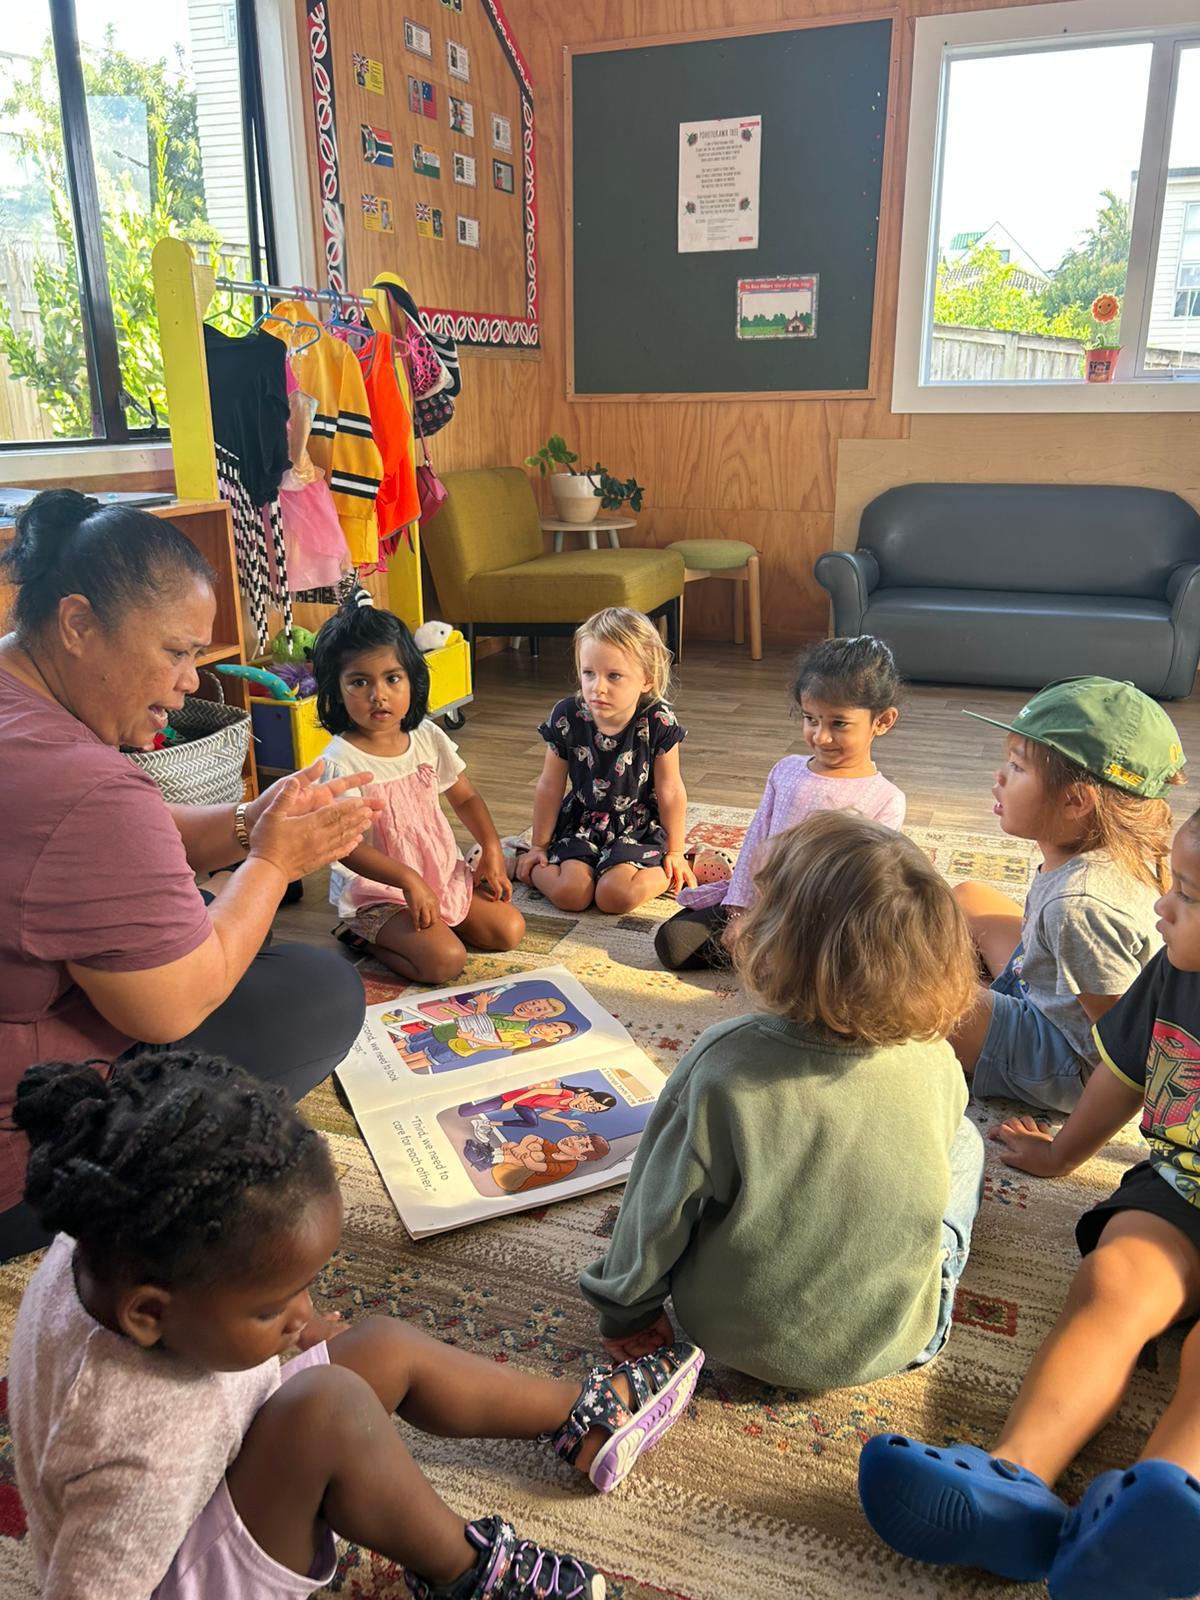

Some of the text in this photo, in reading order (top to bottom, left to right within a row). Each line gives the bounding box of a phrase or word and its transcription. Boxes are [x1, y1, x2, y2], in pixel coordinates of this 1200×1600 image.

[370, 1041, 380, 1051] we
[375, 1051, 391, 1064] need
[383, 1062, 392, 1070] to
[387, 1069, 400, 1082] look
[392, 1120, 406, 1136] care
[400, 1135, 411, 1146] for
[406, 1147, 423, 1167] each
[410, 1115, 449, 1181] "Third, we need to
